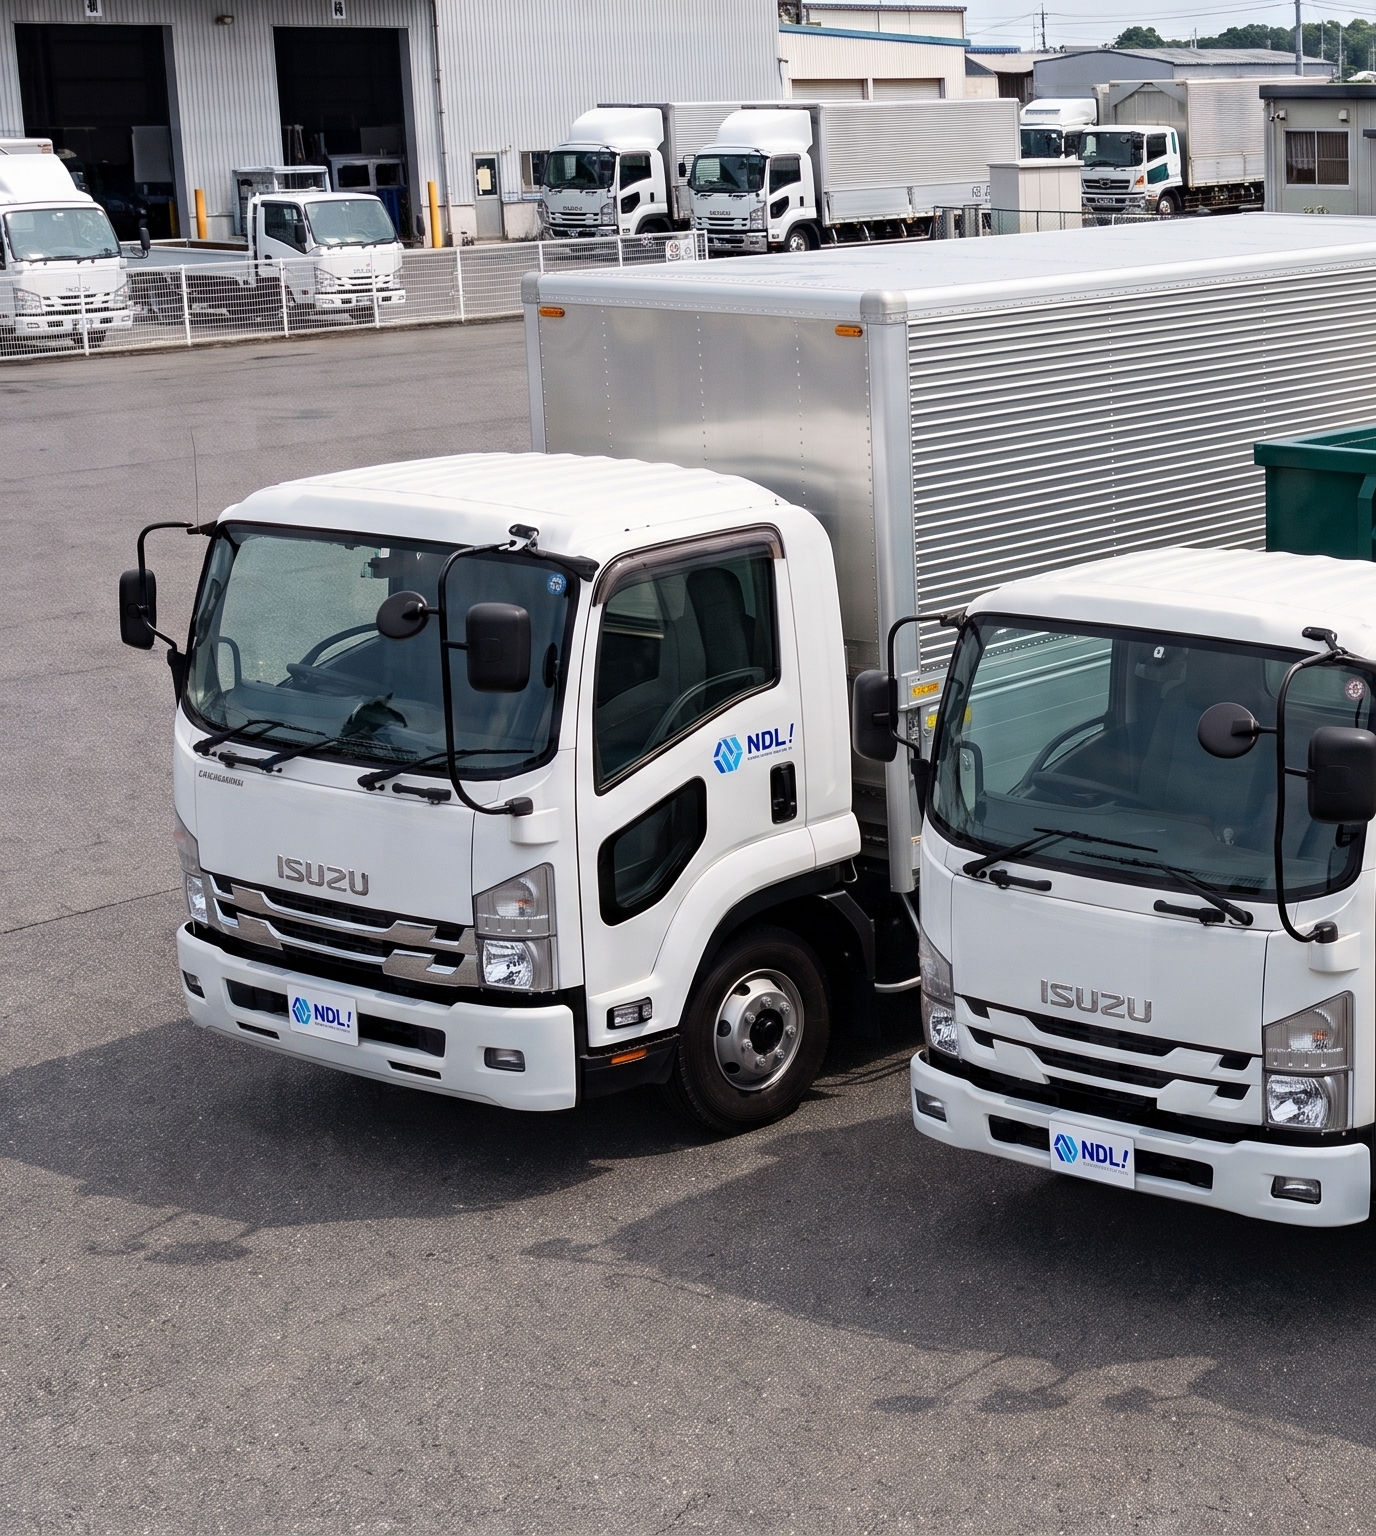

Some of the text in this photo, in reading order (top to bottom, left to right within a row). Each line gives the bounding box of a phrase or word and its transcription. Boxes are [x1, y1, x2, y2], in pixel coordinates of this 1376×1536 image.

[747, 723, 794, 754] NDL!
[277, 854, 369, 897] ISUZU
[314, 1003, 352, 1029] NDL!
[1040, 978, 1152, 1024] ISUZU
[1081, 1140, 1129, 1169] NDL!
